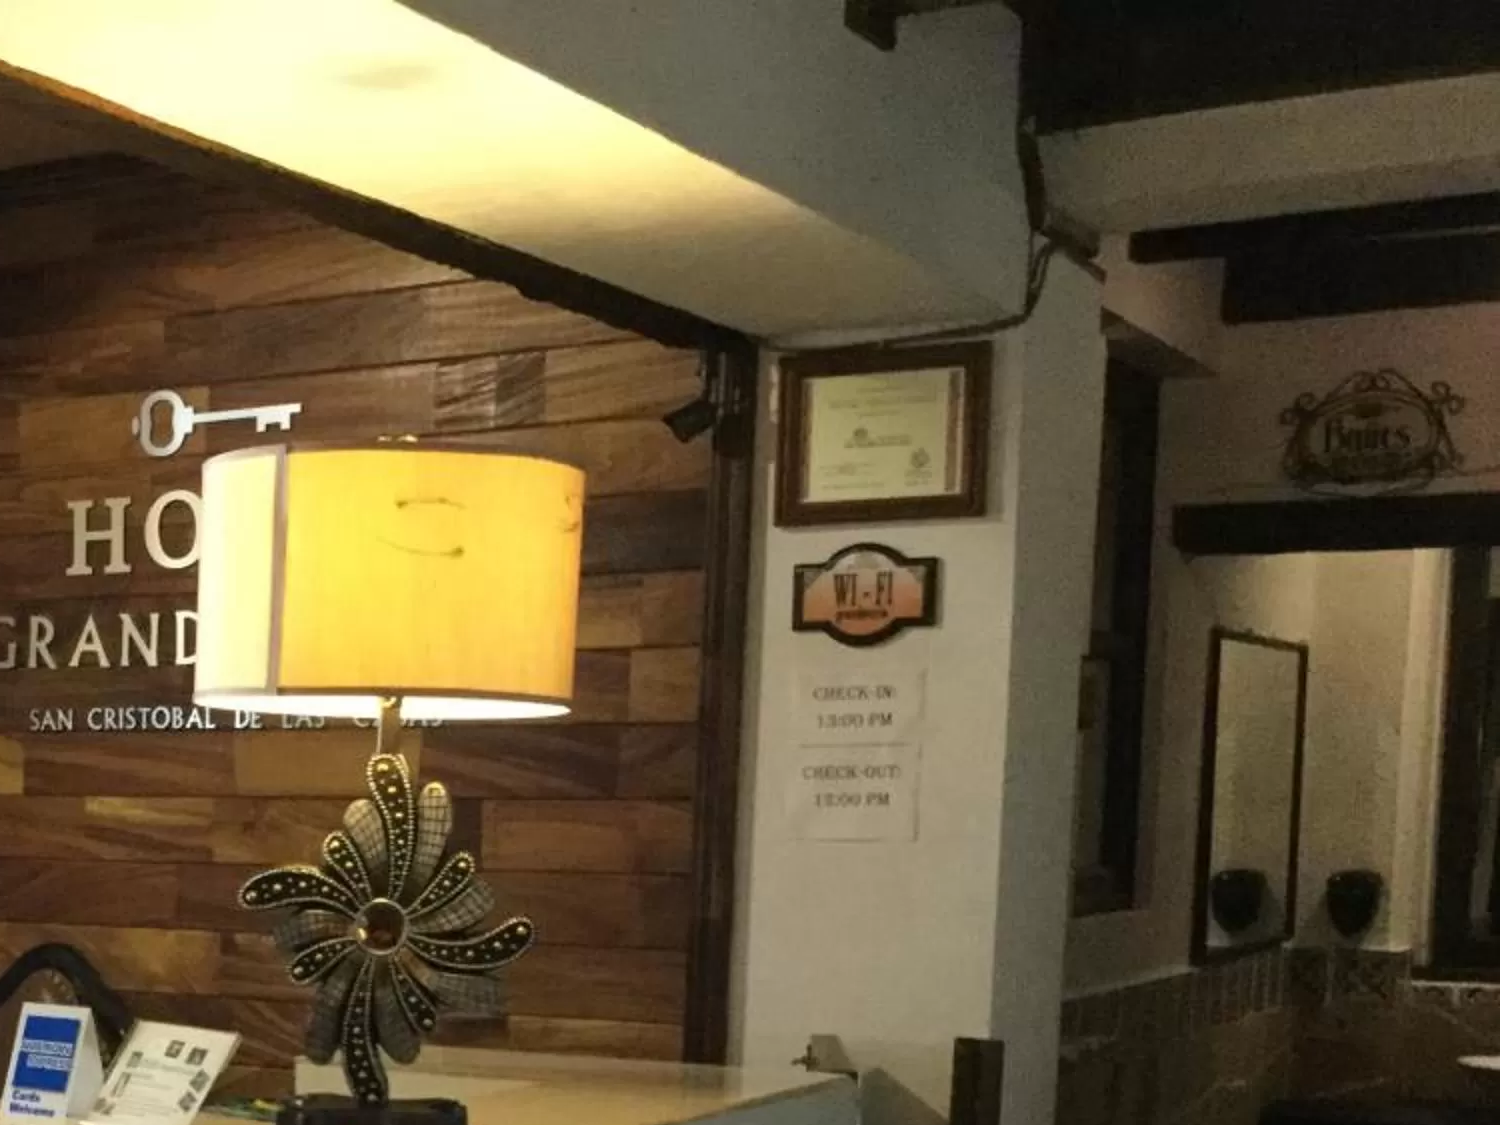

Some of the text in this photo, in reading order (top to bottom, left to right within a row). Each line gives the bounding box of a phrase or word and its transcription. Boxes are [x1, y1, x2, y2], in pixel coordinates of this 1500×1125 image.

[65, 489, 202, 577] HO
[29, 708, 74, 732] SAN
[87, 705, 216, 730] CRISTOBAL
[233, 709, 263, 729] DE
